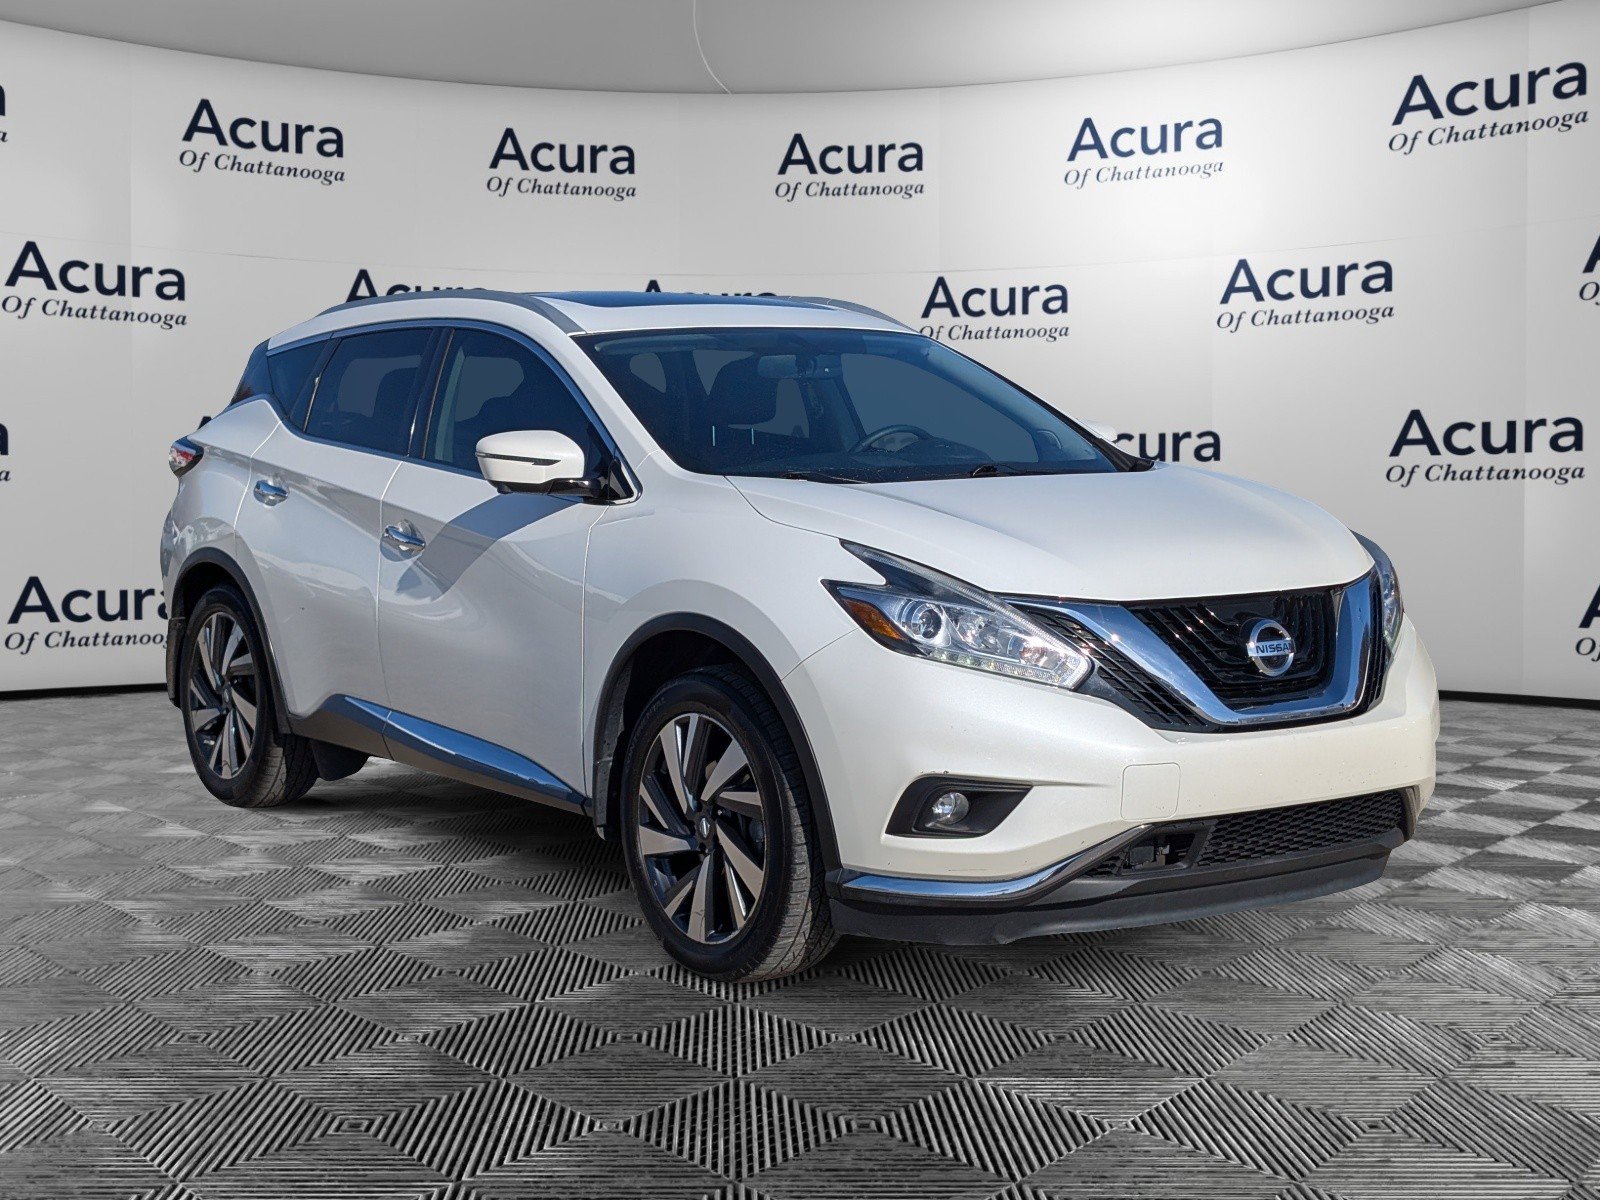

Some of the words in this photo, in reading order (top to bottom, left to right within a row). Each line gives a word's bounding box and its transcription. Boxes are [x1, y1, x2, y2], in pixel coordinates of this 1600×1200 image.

[1391, 61, 1588, 127] Acura
[181, 97, 345, 159] Acura
[1066, 116, 1223, 163] Acura
[1388, 130, 1423, 156] Of
[1427, 110, 1590, 147] Chattanooga
[179, 149, 211, 174] Of
[213, 153, 346, 187] Chattanooga
[488, 126, 636, 176] Acura
[776, 132, 924, 176] Acura
[486, 175, 514, 198] Of
[516, 177, 637, 202] Chattanooga
[774, 181, 802, 203] Of
[804, 180, 925, 200] Chattanooga
[1063, 167, 1092, 190] Of
[1095, 161, 1224, 184] Chattanooga
[3, 240, 186, 302] Acura
[1219, 258, 1394, 306] Acura
[1, 295, 38, 320] Of
[41, 298, 188, 331] Chattanooga
[920, 275, 1069, 320] Acura
[947, 324, 1070, 343] Chattanooga
[1216, 310, 1247, 334] Of
[1250, 305, 1395, 327] Chattanooga
[1114, 430, 1221, 463] ura
[1388, 408, 1585, 458] Acura
[1385, 463, 1421, 489] Of
[1424, 463, 1586, 486] Chattanooga
[4, 630, 40, 656] Of
[44, 629, 168, 649] Chattanoo
